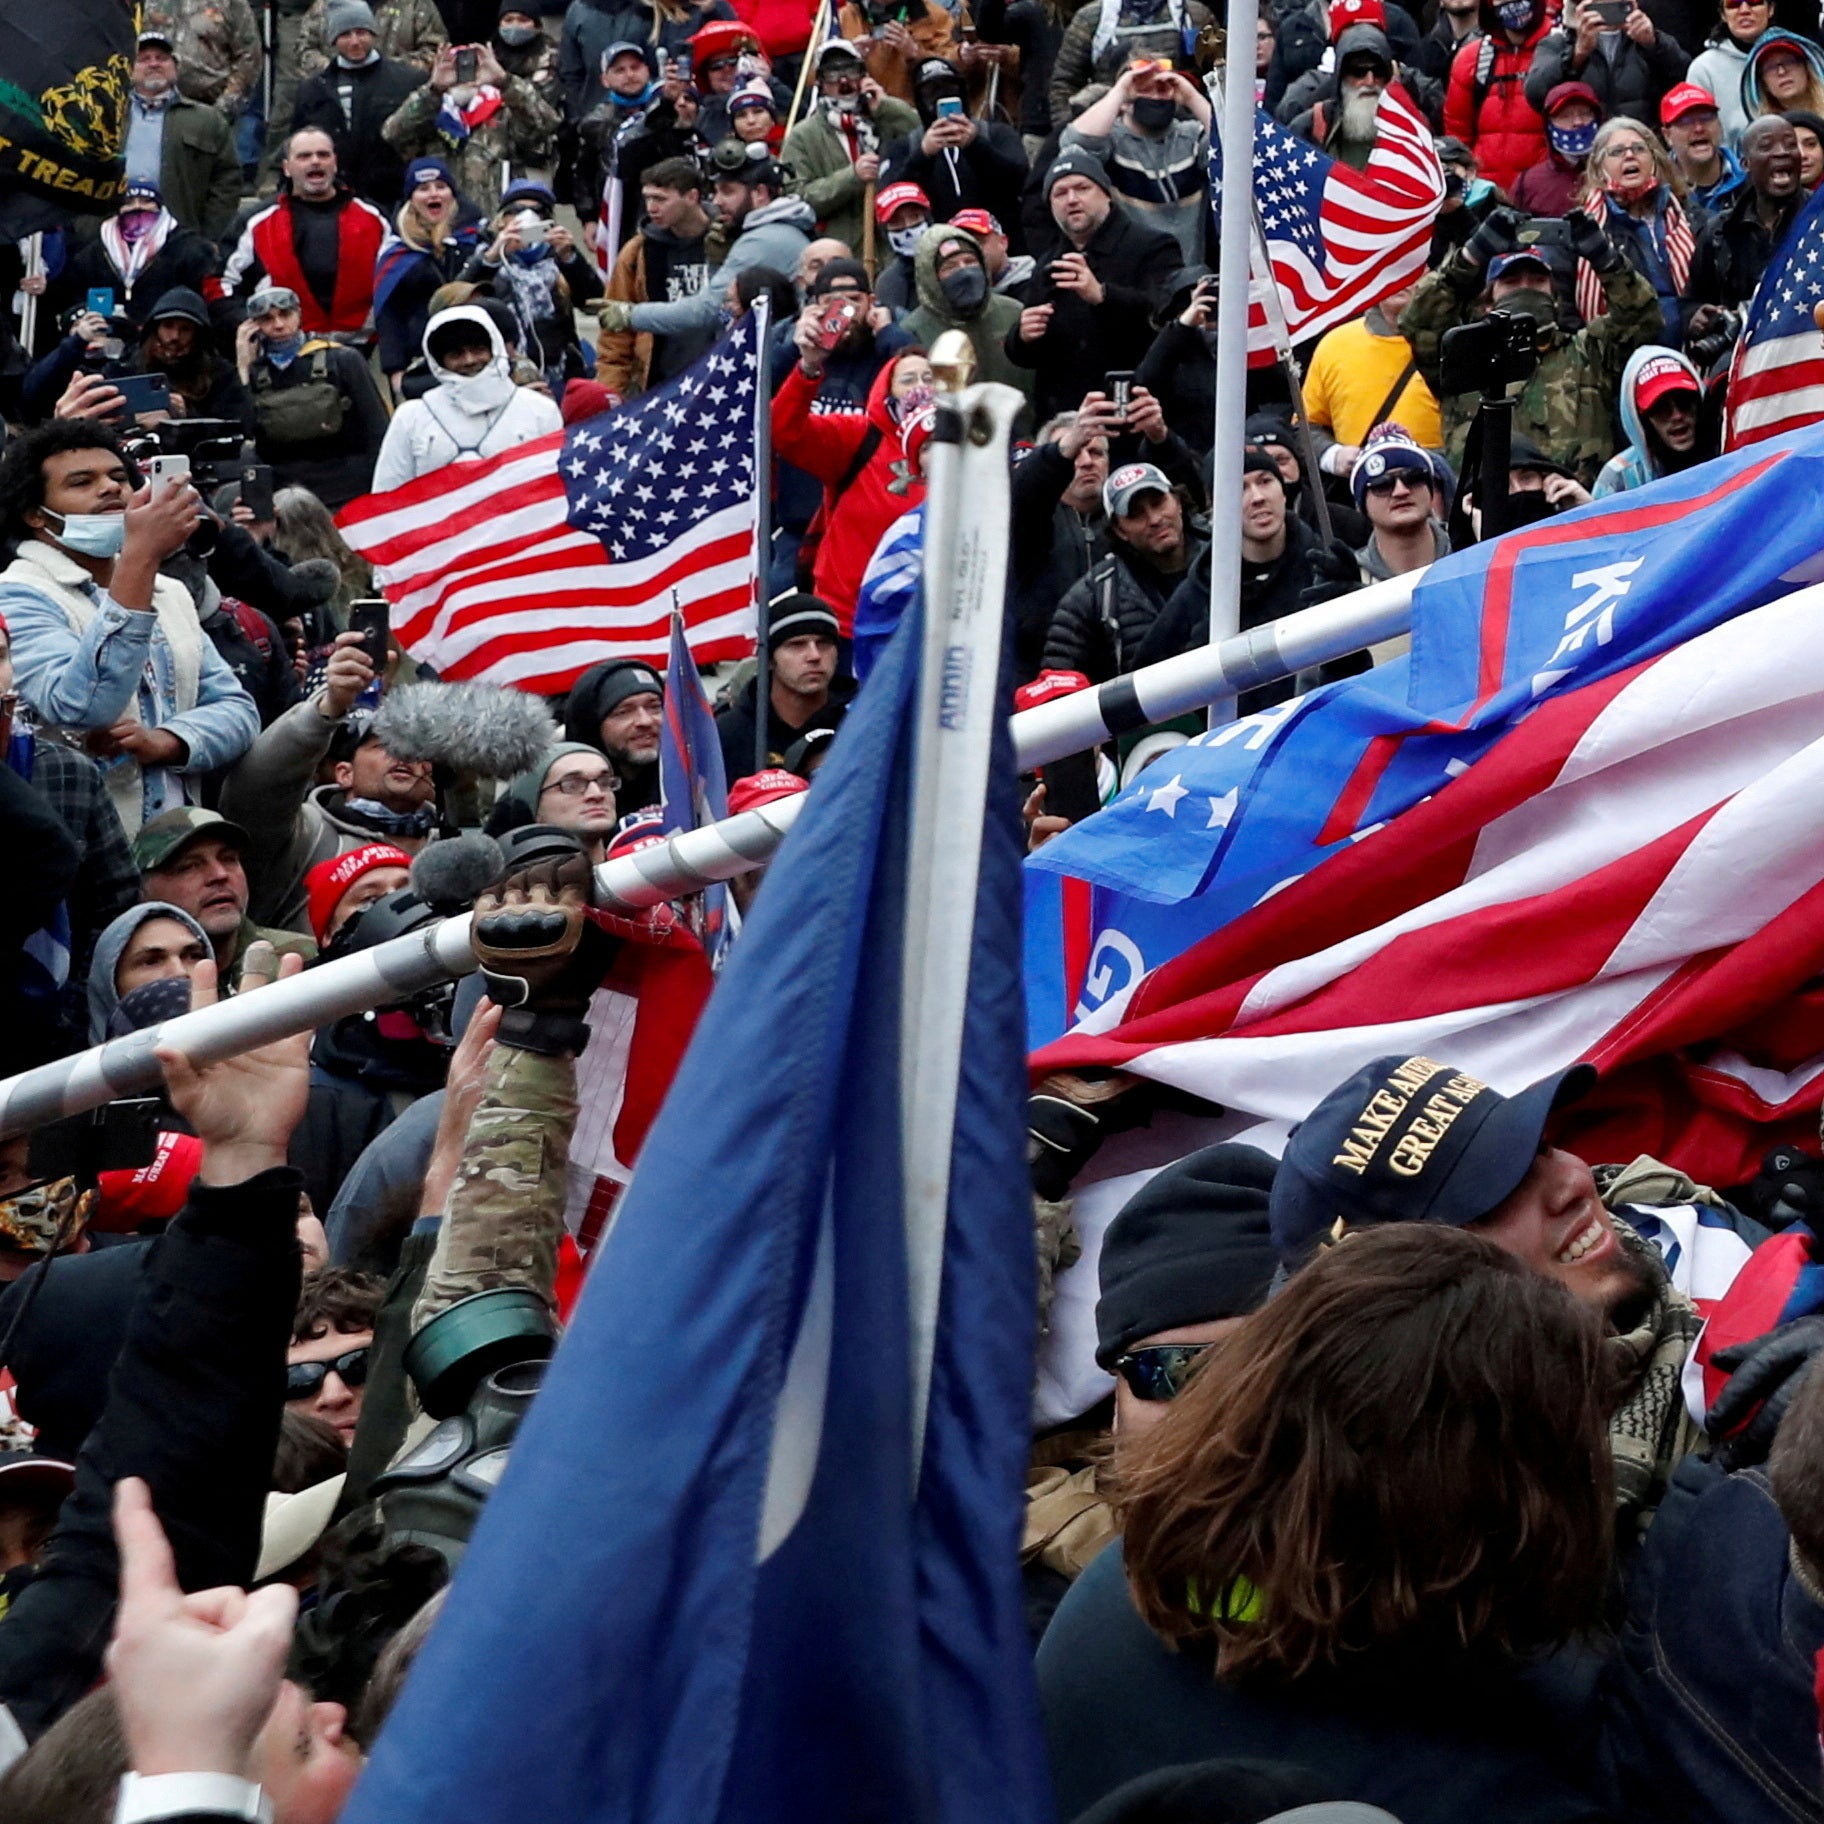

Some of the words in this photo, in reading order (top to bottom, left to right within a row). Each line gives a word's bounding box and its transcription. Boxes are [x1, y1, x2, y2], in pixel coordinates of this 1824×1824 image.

[16, 150, 123, 201] TREAD
[940, 645, 965, 731] Annin
[1332, 1088, 1405, 1176] MAKE
[1388, 1093, 1453, 1177] GREAT
